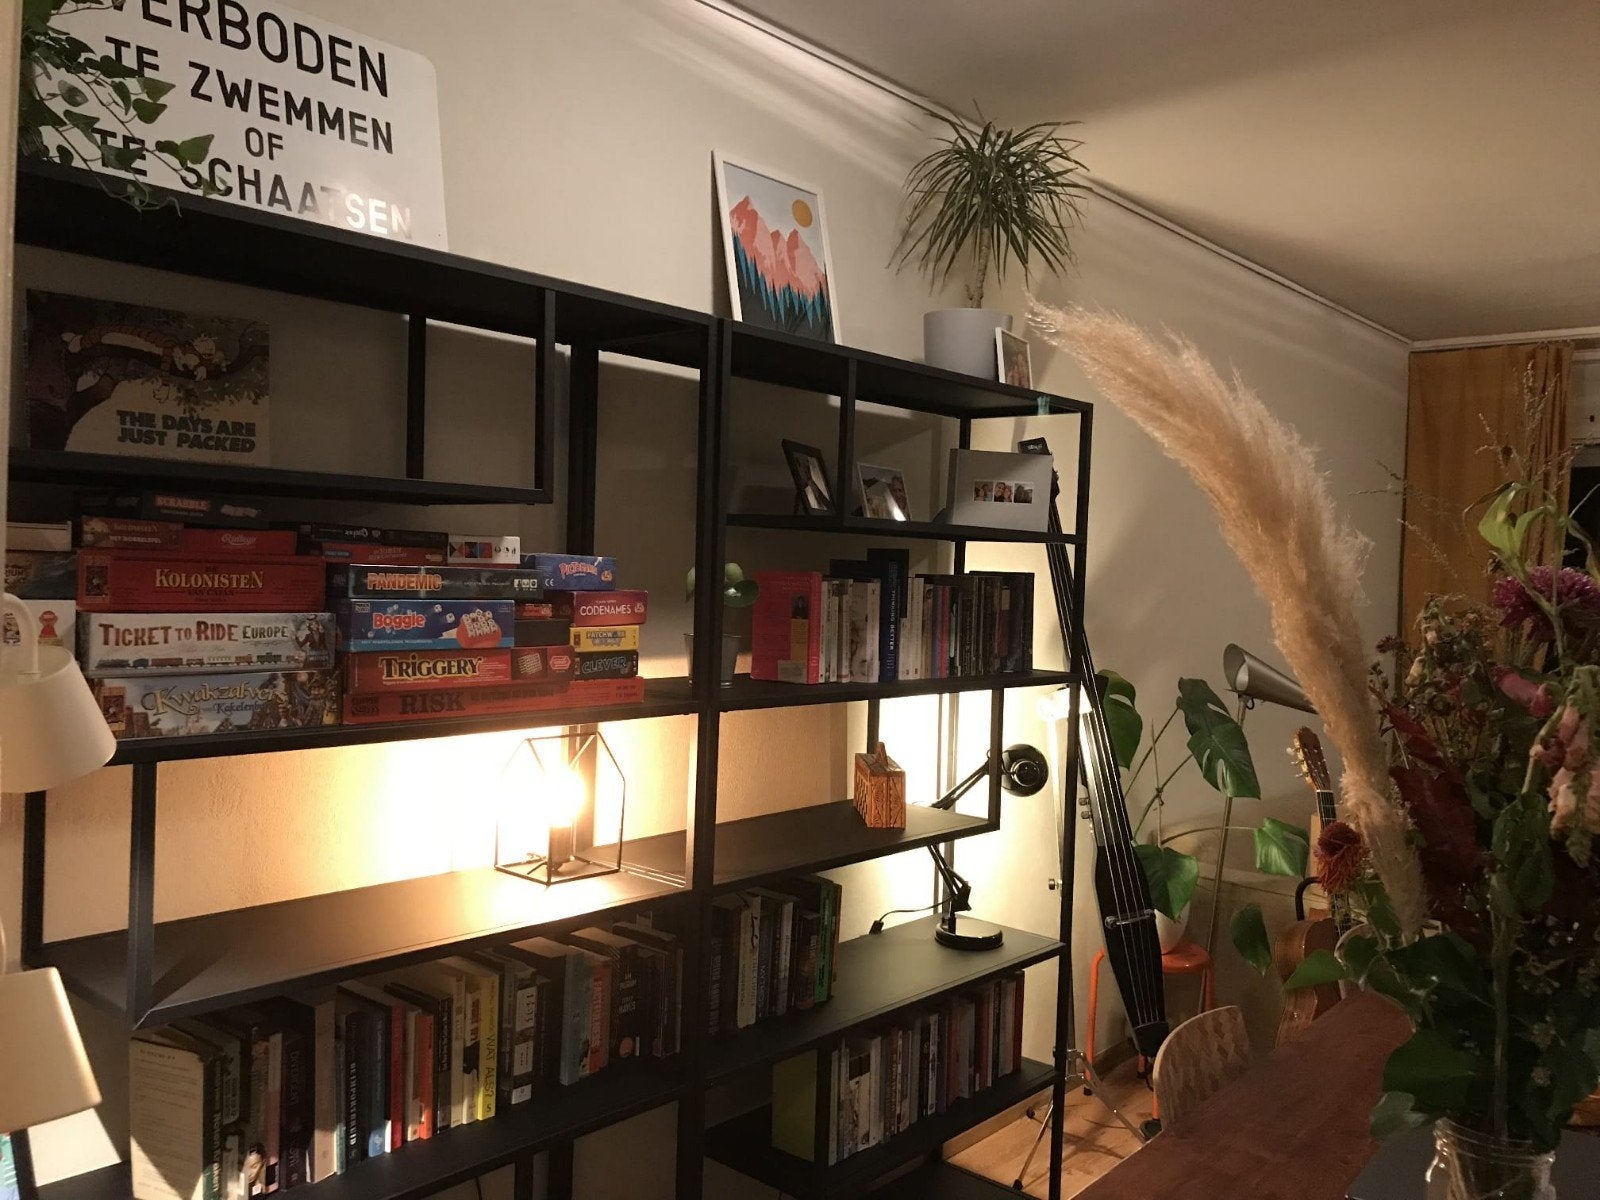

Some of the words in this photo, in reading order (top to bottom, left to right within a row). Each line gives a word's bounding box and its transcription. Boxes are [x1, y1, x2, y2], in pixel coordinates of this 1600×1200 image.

[101, 0, 389, 97] ERBODEN
[188, 61, 393, 154] ZWEMMEN
[245, 126, 284, 161] OF
[116, 410, 156, 428] THE
[162, 414, 213, 433] DAYS
[216, 420, 256, 437] ARE
[117, 428, 168, 446] JUST
[176, 433, 256, 452] PACKED
[154, 568, 264, 590] KOLONISTEN
[366, 572, 442, 592] PANDEMIC
[372, 612, 426, 630] Boggle
[579, 604, 632, 617] CODENAMES
[98, 622, 172, 647] TICKET
[175, 628, 191, 642] TO
[195, 620, 239, 642] RIDE
[242, 625, 288, 640] EUROPE
[582, 655, 627, 674] CLEVER
[141, 682, 288, 716] Kwakzalvers
[400, 691, 466, 714] RISK
[484, 1033, 496, 1062] WAT
[483, 1067, 496, 1100] ALS?
